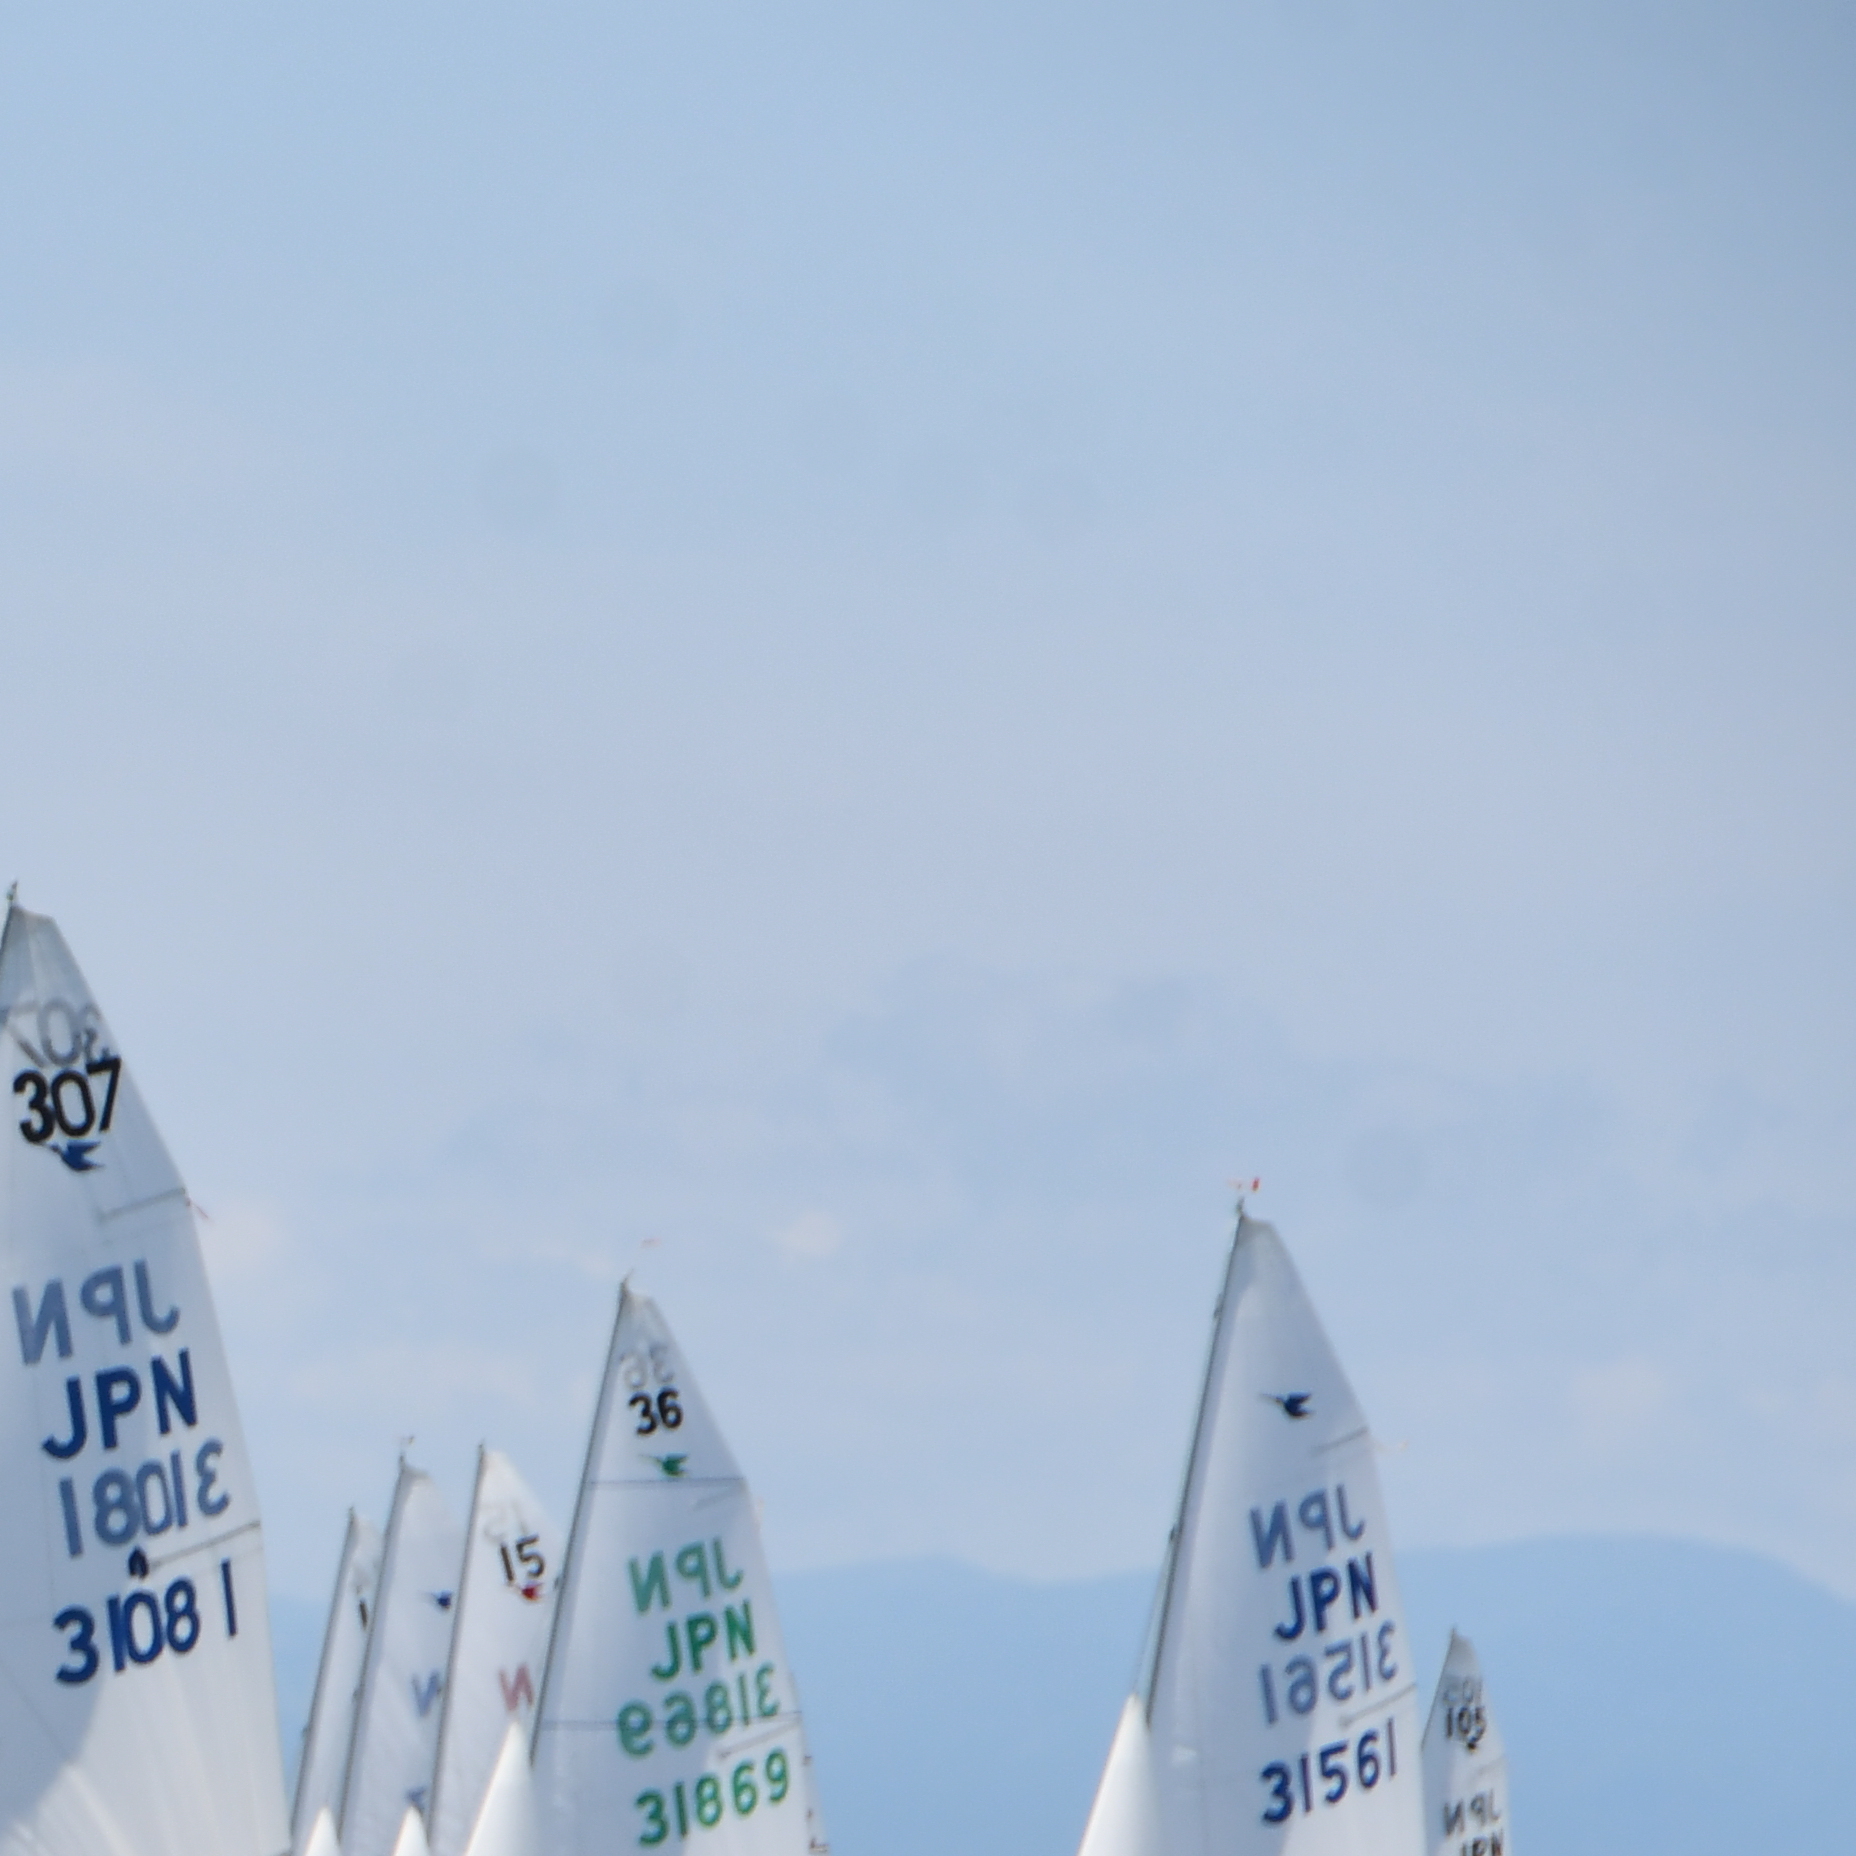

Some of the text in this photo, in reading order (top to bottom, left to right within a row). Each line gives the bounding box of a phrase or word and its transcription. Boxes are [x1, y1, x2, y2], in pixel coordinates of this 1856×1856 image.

[13, 1056, 122, 1144] 307
[42, 1347, 199, 1460] JPN
[628, 1385, 684, 1437] 36
[499, 1535, 547, 1585] 15
[1273, 1552, 1379, 1643] JPN
[53, 1558, 240, 1688] 31081
[650, 1600, 757, 1683] JPN
[634, 1745, 791, 1850] 31869
[1259, 1718, 1400, 1826] 31561
